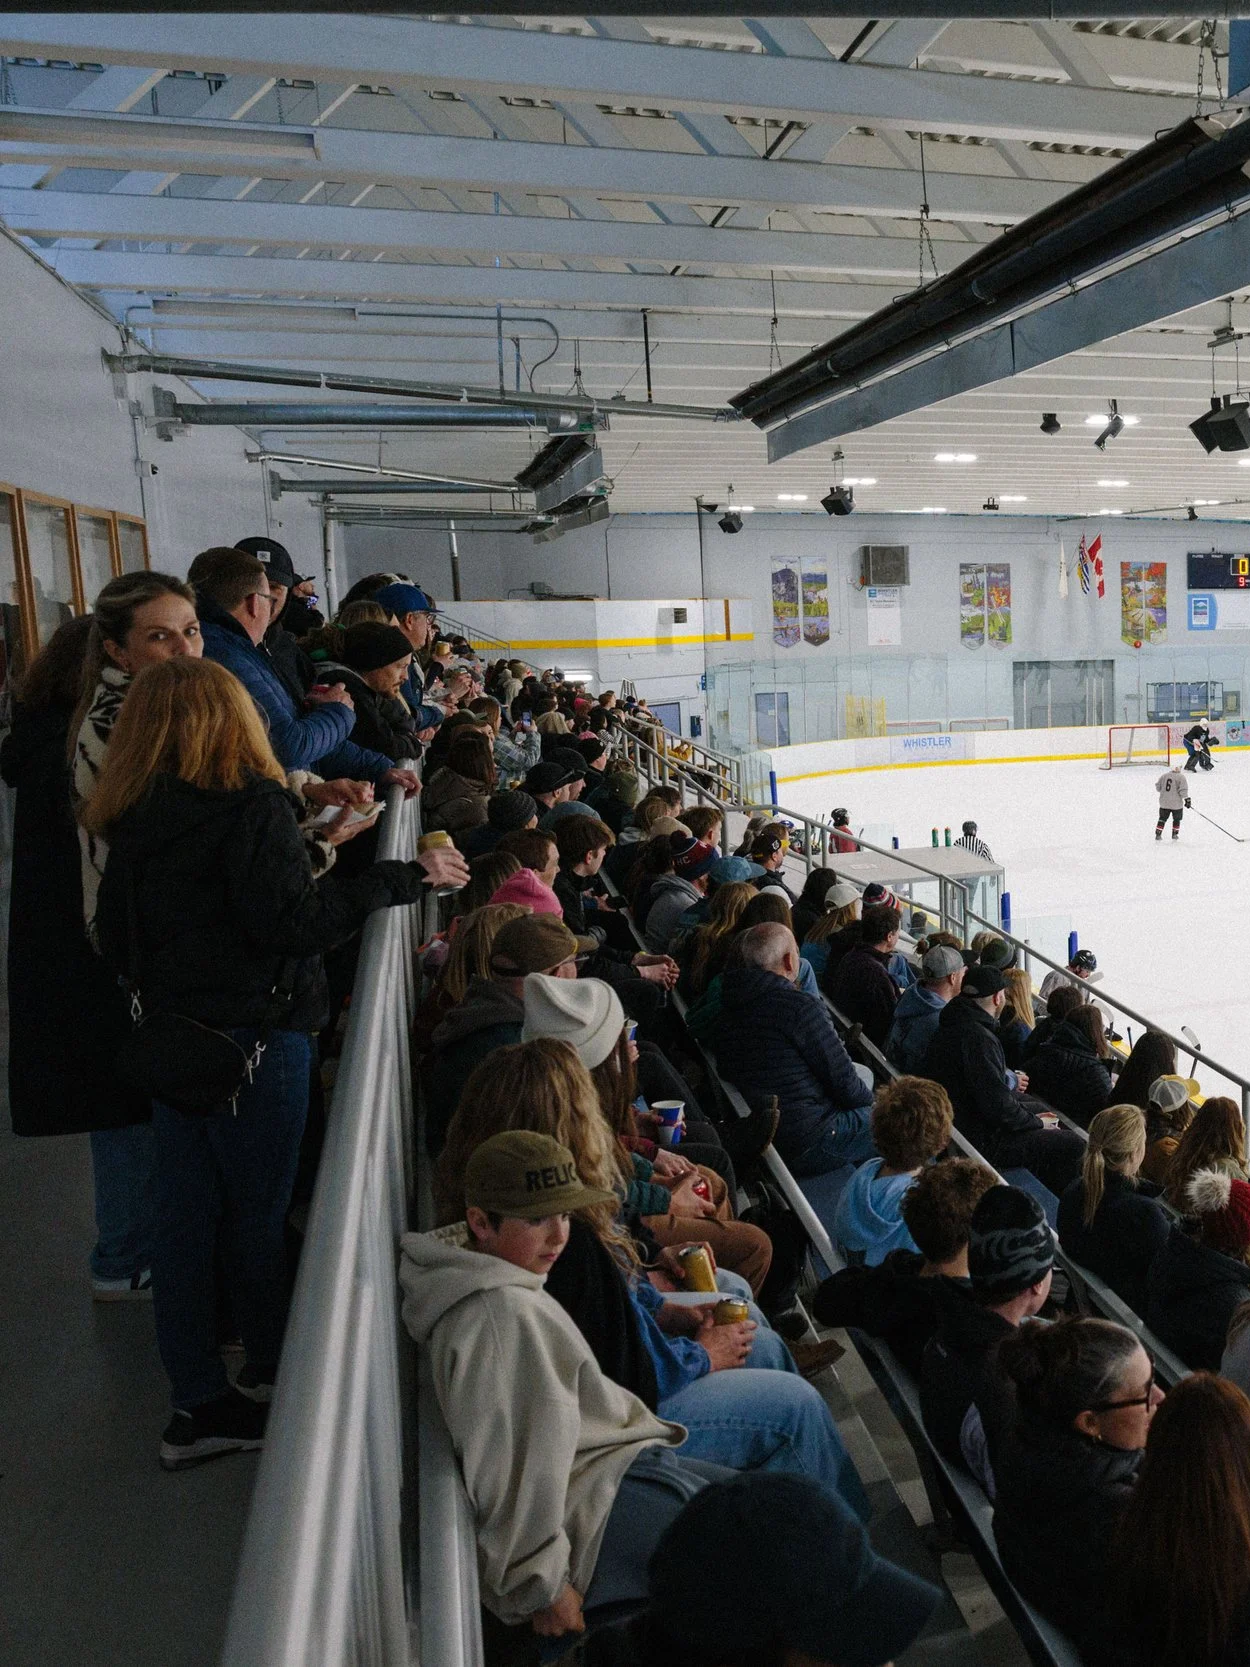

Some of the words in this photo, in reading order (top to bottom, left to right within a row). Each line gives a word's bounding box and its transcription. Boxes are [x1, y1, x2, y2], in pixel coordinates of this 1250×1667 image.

[1239, 558, 1248, 574] 0
[1238, 576, 1244, 586] 9
[903, 736, 952, 748] WHISTLER
[1166, 779, 1172, 792] 6
